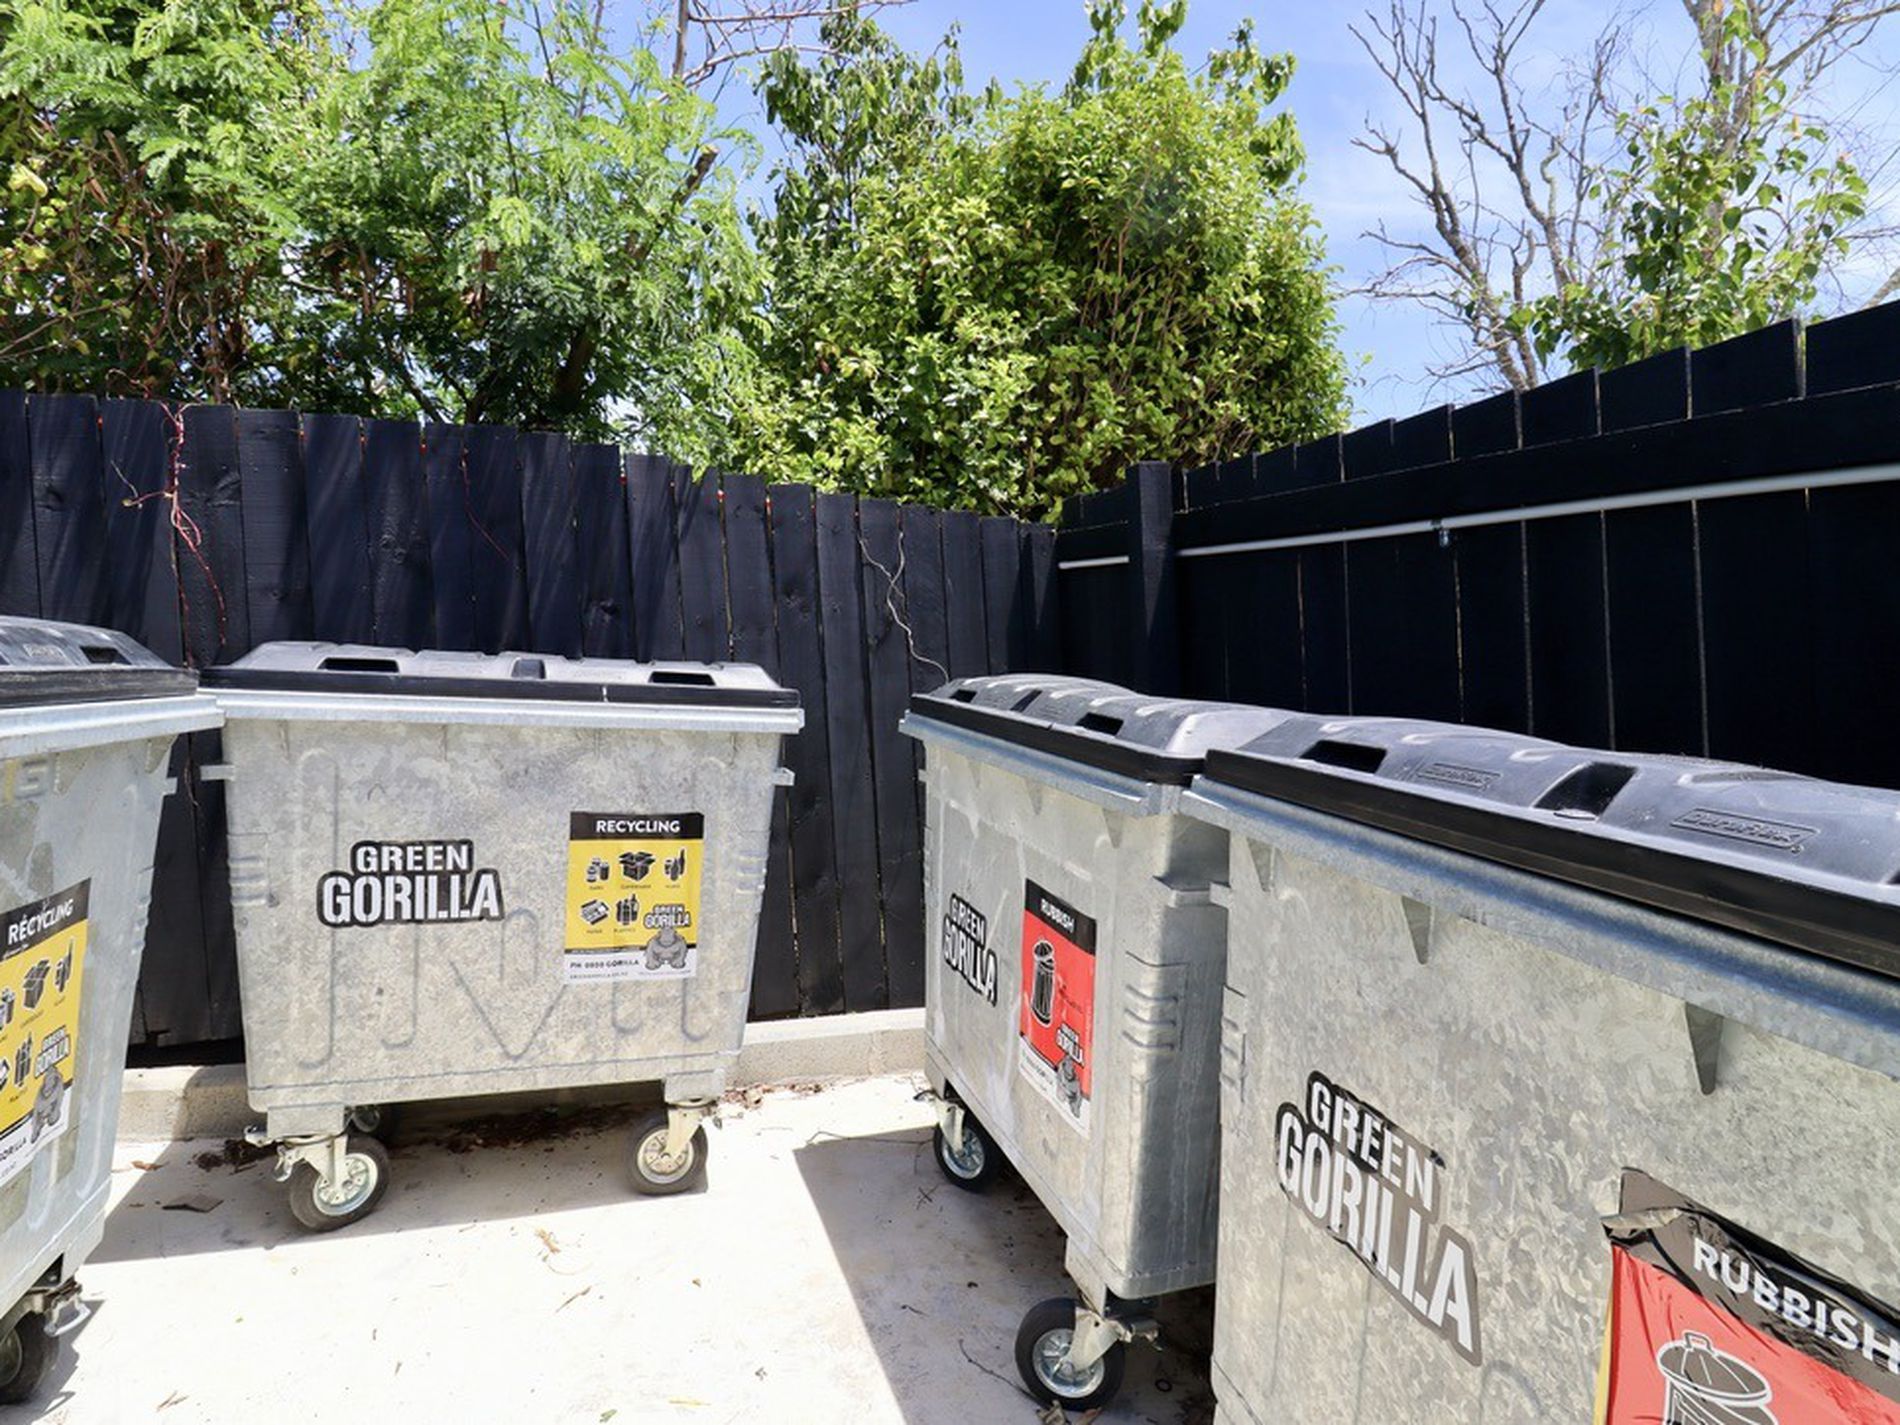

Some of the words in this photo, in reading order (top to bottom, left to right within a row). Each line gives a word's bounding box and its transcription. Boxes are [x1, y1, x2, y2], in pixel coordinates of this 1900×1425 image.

[595, 819, 681, 834] RECYCLING
[355, 844, 469, 873] GREEN
[8, 898, 74, 946] RECYCLING
[322, 873, 500, 924] GORILLA
[645, 912, 691, 928] GORILLA
[951, 897, 986, 946] GREEN
[1041, 898, 1075, 933] RUBBISH
[944, 915, 997, 1002] GORILLA
[1309, 1080, 1435, 1210] GREEN
[1277, 1109, 1474, 1353] GORILLA
[1694, 1237, 1900, 1375] RUBBISH
